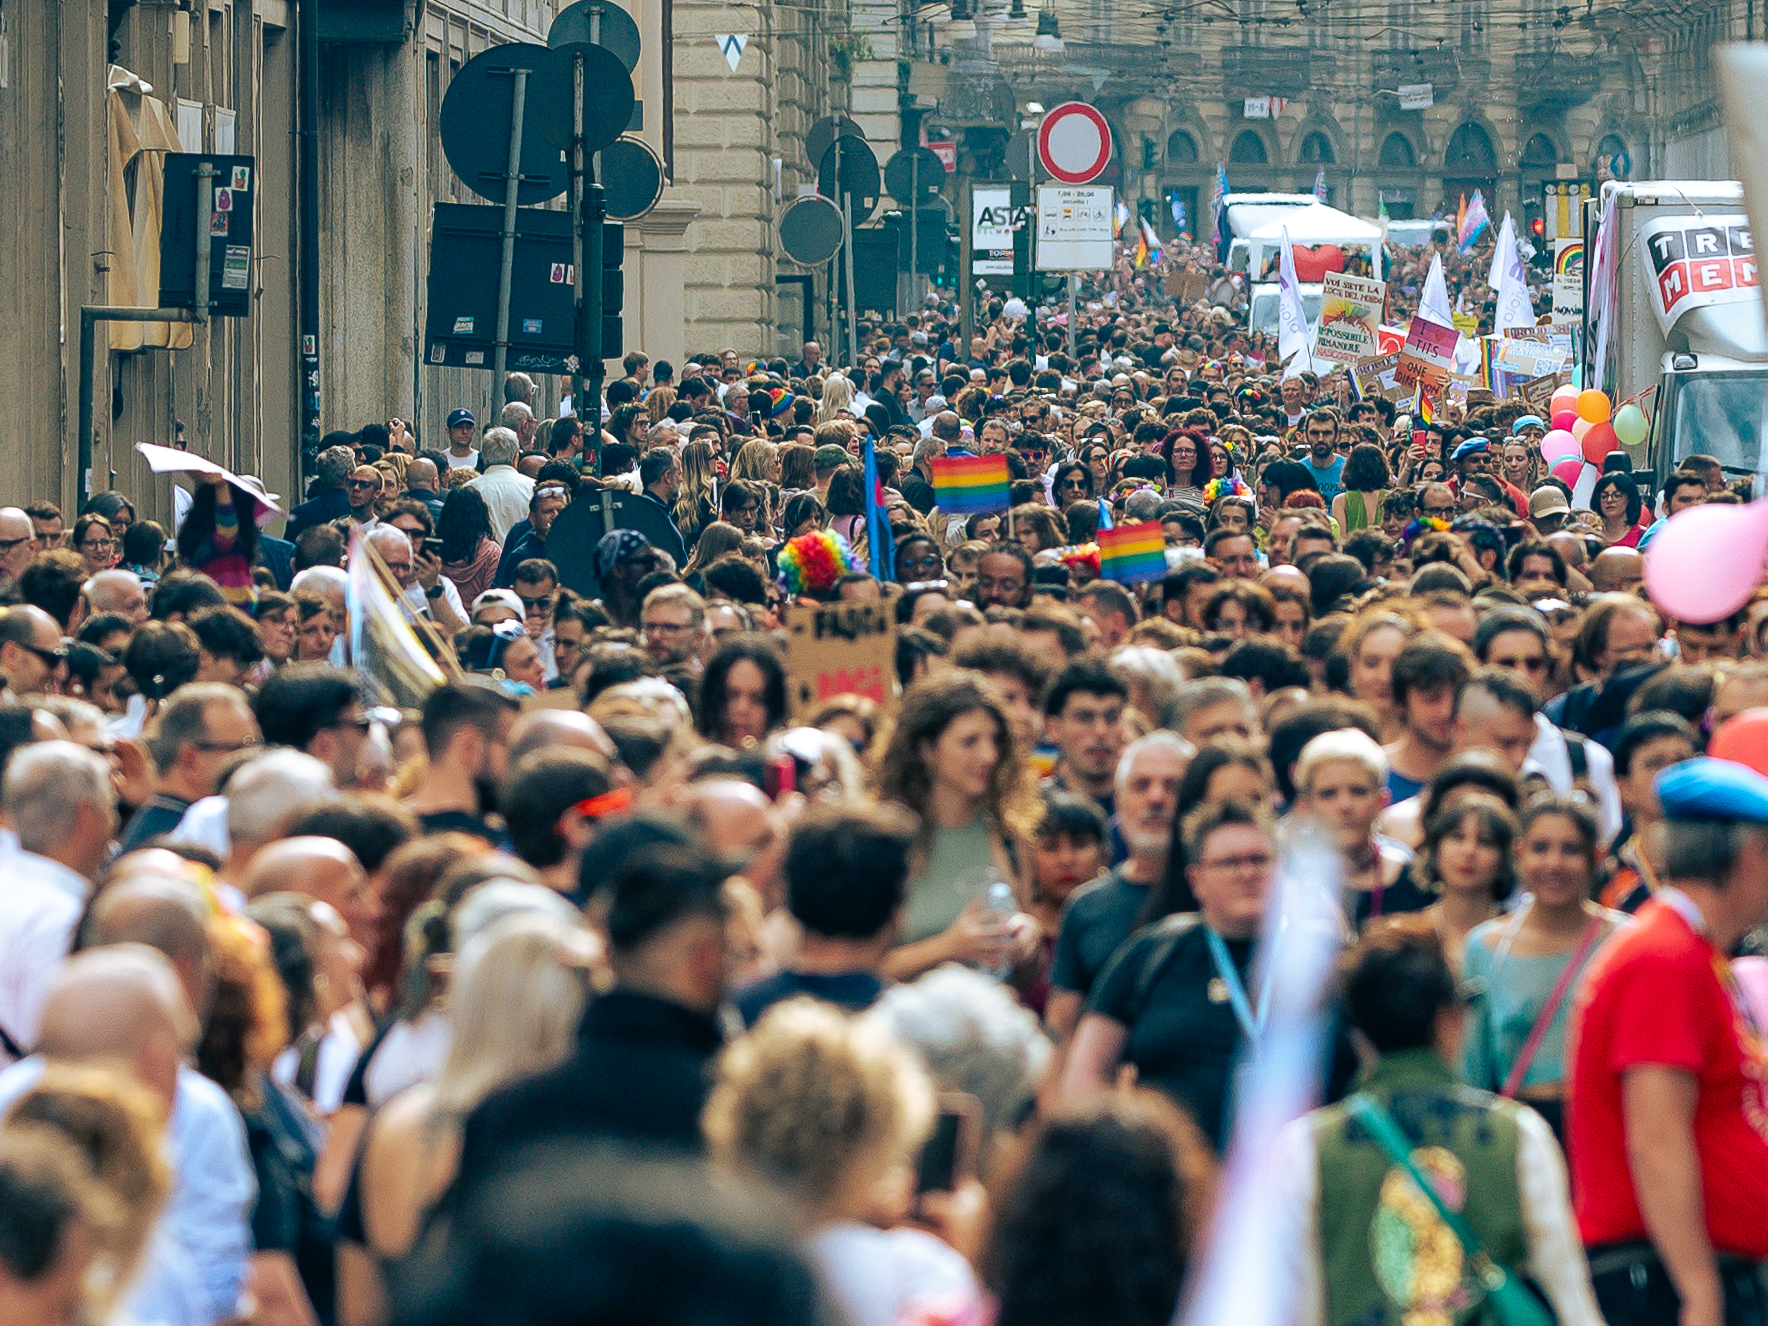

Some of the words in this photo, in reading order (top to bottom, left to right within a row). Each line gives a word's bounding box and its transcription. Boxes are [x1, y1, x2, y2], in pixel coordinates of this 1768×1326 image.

[978, 206, 1026, 226] ASTA
[1325, 277, 1340, 287] VOI
[1343, 281, 1365, 292] SIETE
[1367, 285, 1379, 294] LA
[1503, 285, 1525, 323] viola
[1415, 339, 1440, 358] TITS
[1407, 361, 1428, 377] ONE
[1396, 371, 1441, 395] DIRETION
